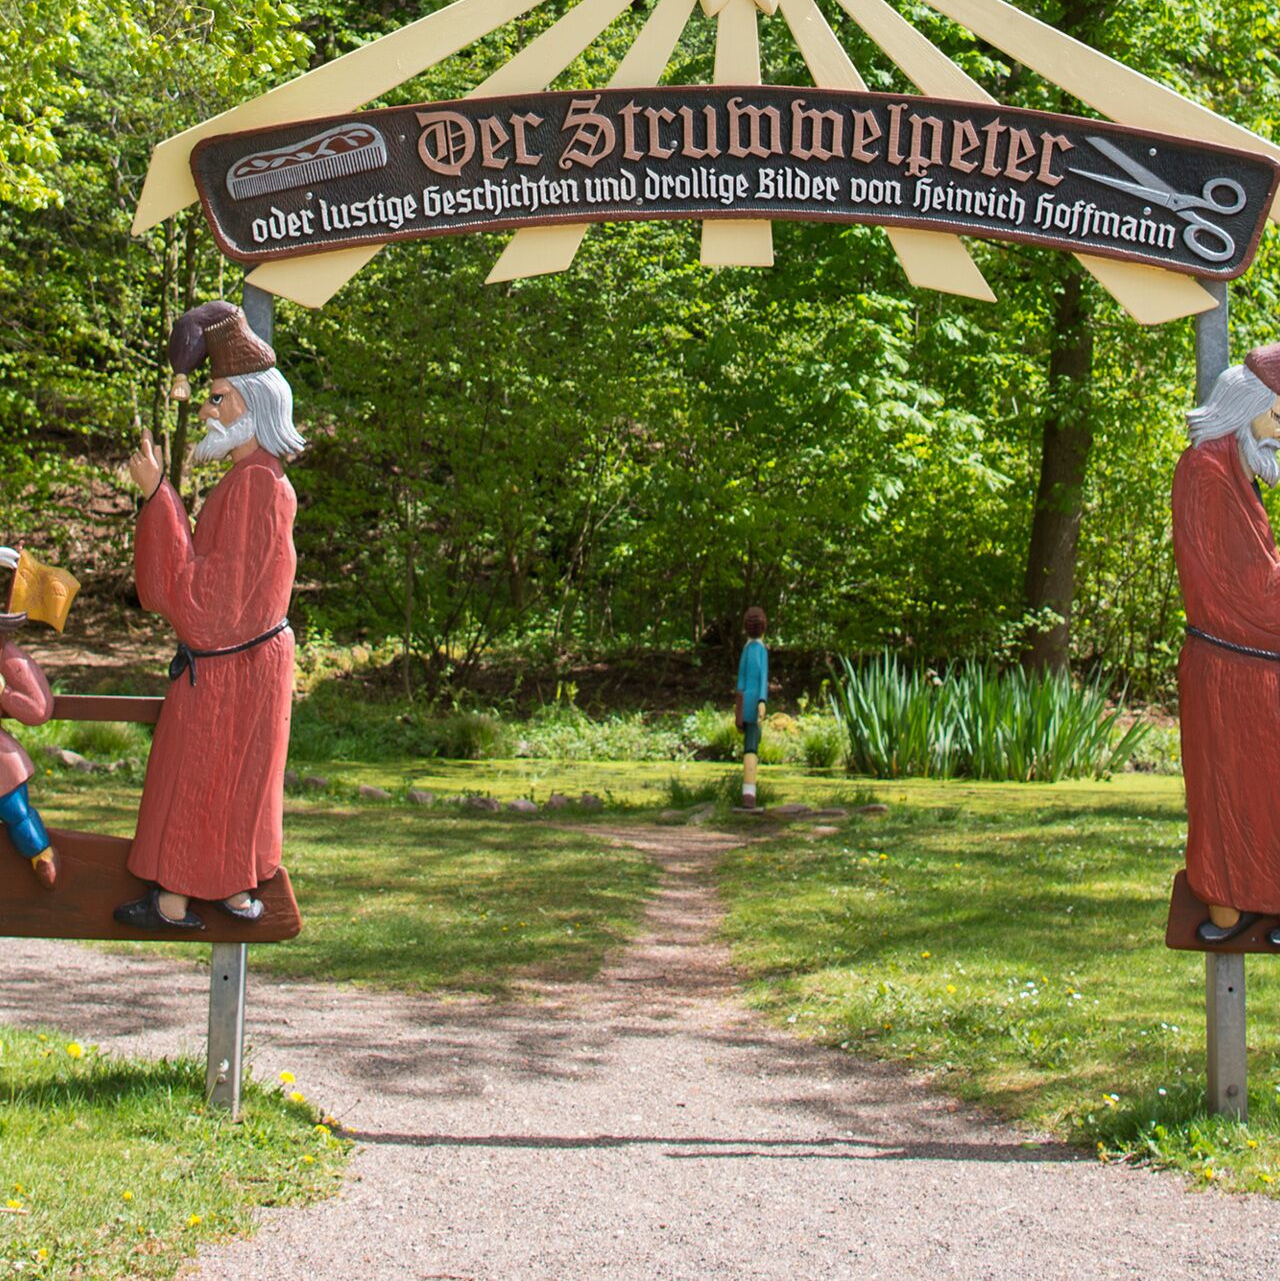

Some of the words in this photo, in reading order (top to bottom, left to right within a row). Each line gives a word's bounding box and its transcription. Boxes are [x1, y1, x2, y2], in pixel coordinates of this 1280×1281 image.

[416, 110, 544, 176] Der
[558, 94, 1075, 186] Struwwelpeter
[252, 207, 315, 243] oder
[321, 192, 417, 231] lustige
[423, 172, 580, 216] Geschichten
[585, 170, 636, 204] und
[644, 168, 748, 204] drollige
[755, 167, 840, 203] Bilder
[850, 175, 902, 206] von
[914, 177, 1026, 226] Heinrich
[1034, 193, 1175, 250] Hoffmann
